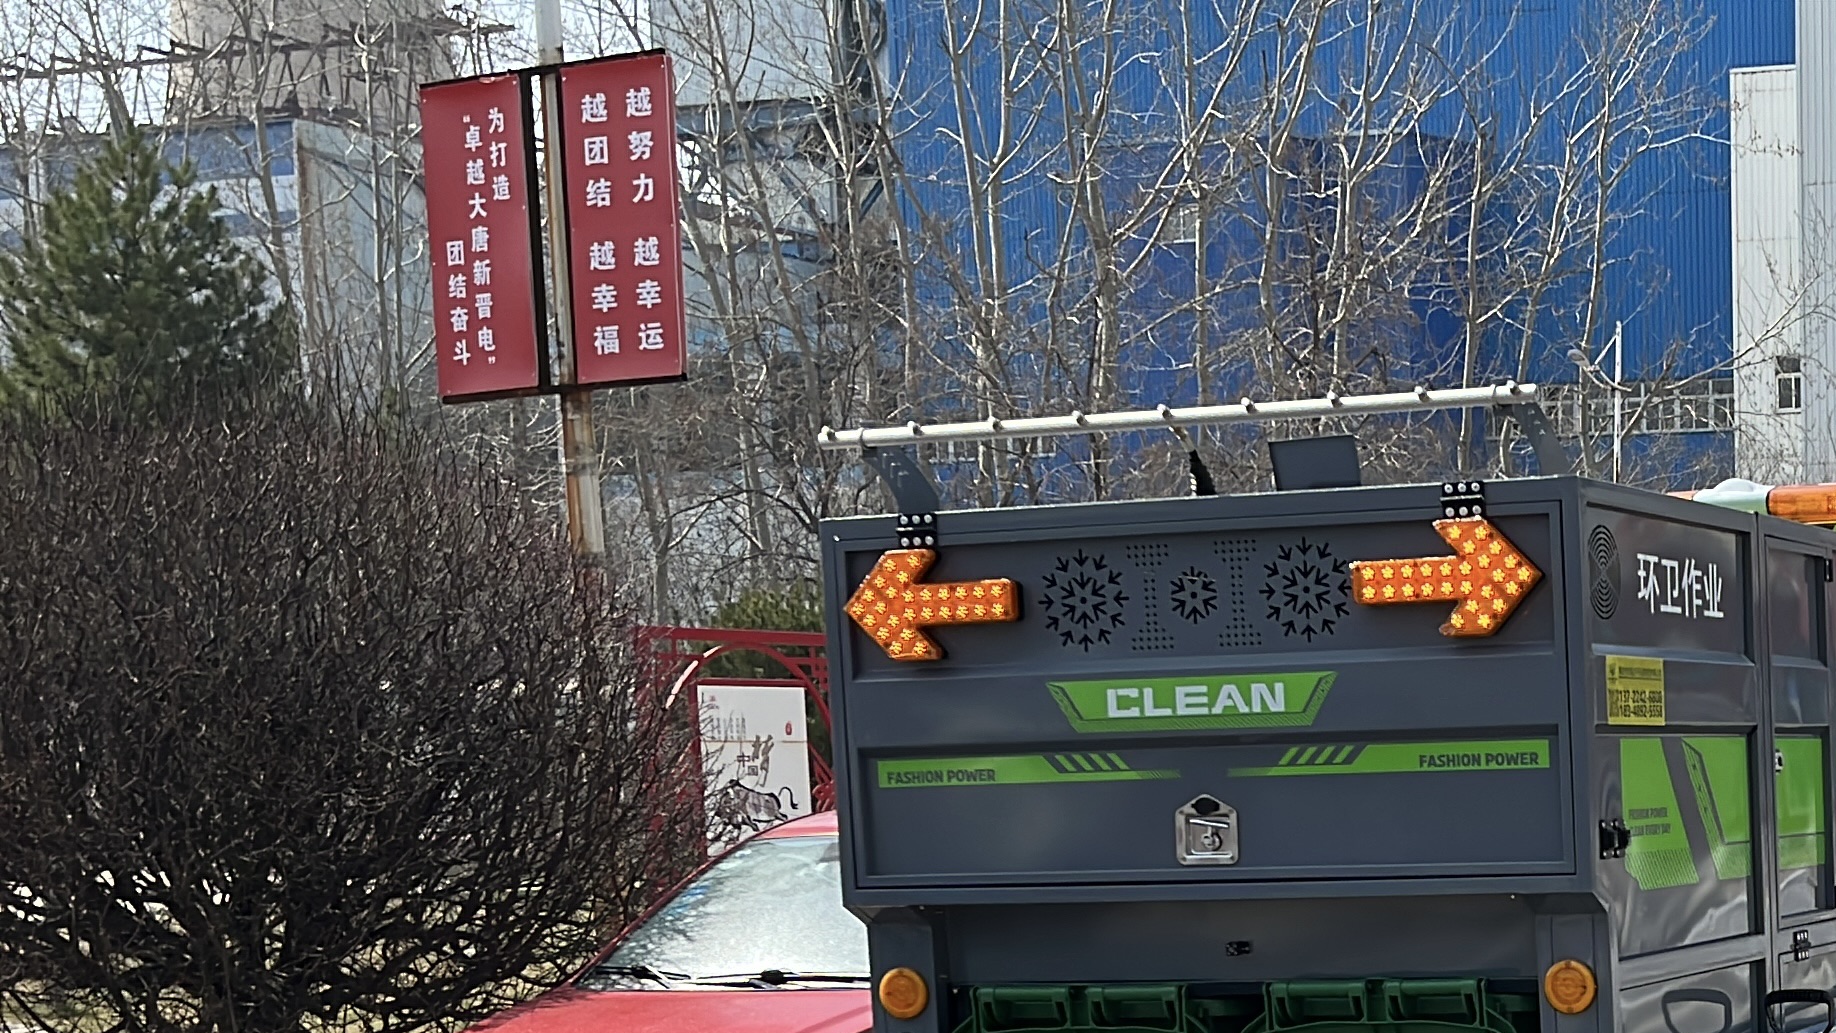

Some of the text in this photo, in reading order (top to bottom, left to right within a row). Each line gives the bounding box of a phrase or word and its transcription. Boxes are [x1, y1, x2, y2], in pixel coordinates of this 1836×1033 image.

[487, 106, 511, 202] 为打造
[581, 93, 620, 355] 越团结 越幸福
[626, 87, 664, 351] 越努力 越幸运
[446, 240, 471, 366] 团结奋斗
[1636, 552, 1724, 619] 环卫作业
[1106, 681, 1286, 719] CLEAN
[887, 769, 996, 785] FASHION POWER
[1418, 752, 1539, 768] FASHION POWER
